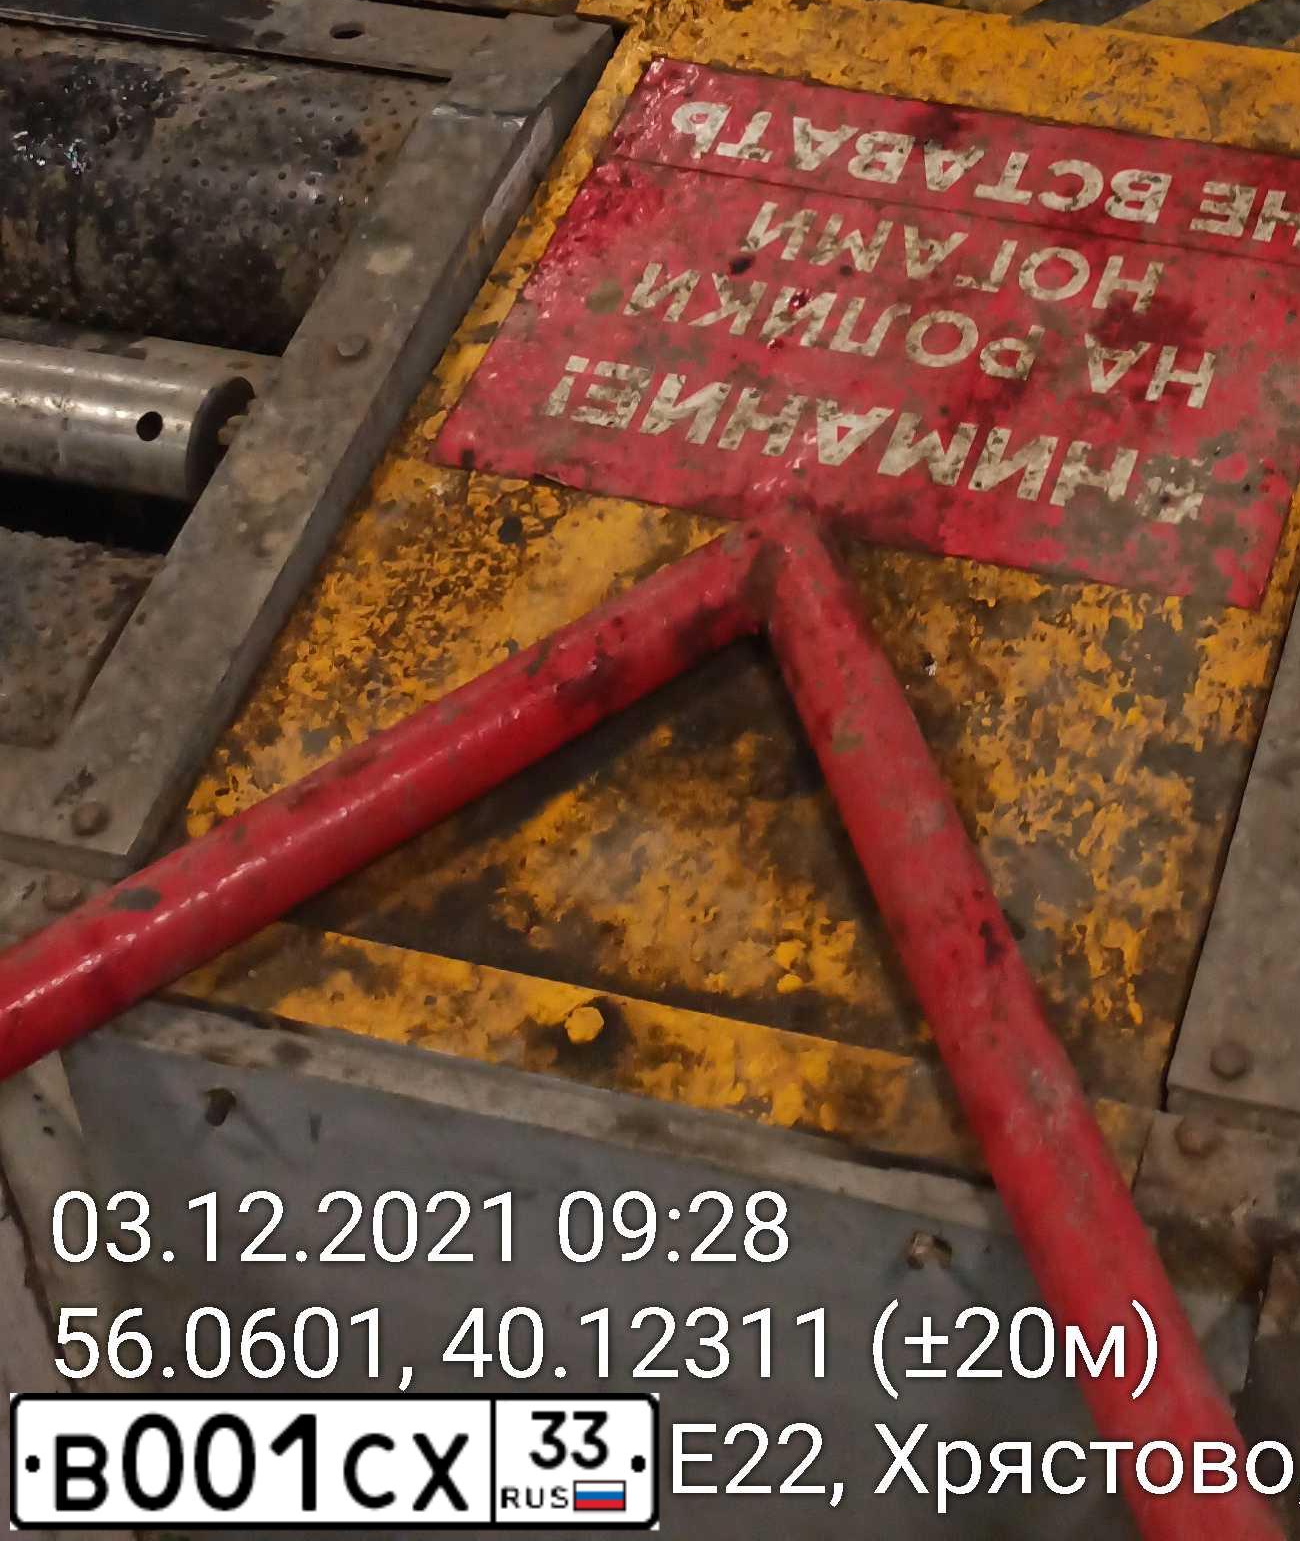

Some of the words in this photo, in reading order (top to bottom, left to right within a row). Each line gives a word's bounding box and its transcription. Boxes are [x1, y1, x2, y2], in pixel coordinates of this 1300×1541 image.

[670, 101, 1174, 224] ВСТАВАТЬ
[742, 201, 1165, 314] НОГАМИ
[623, 260, 1045, 382] РОЛИКИ
[1084, 332, 1215, 408] НА
